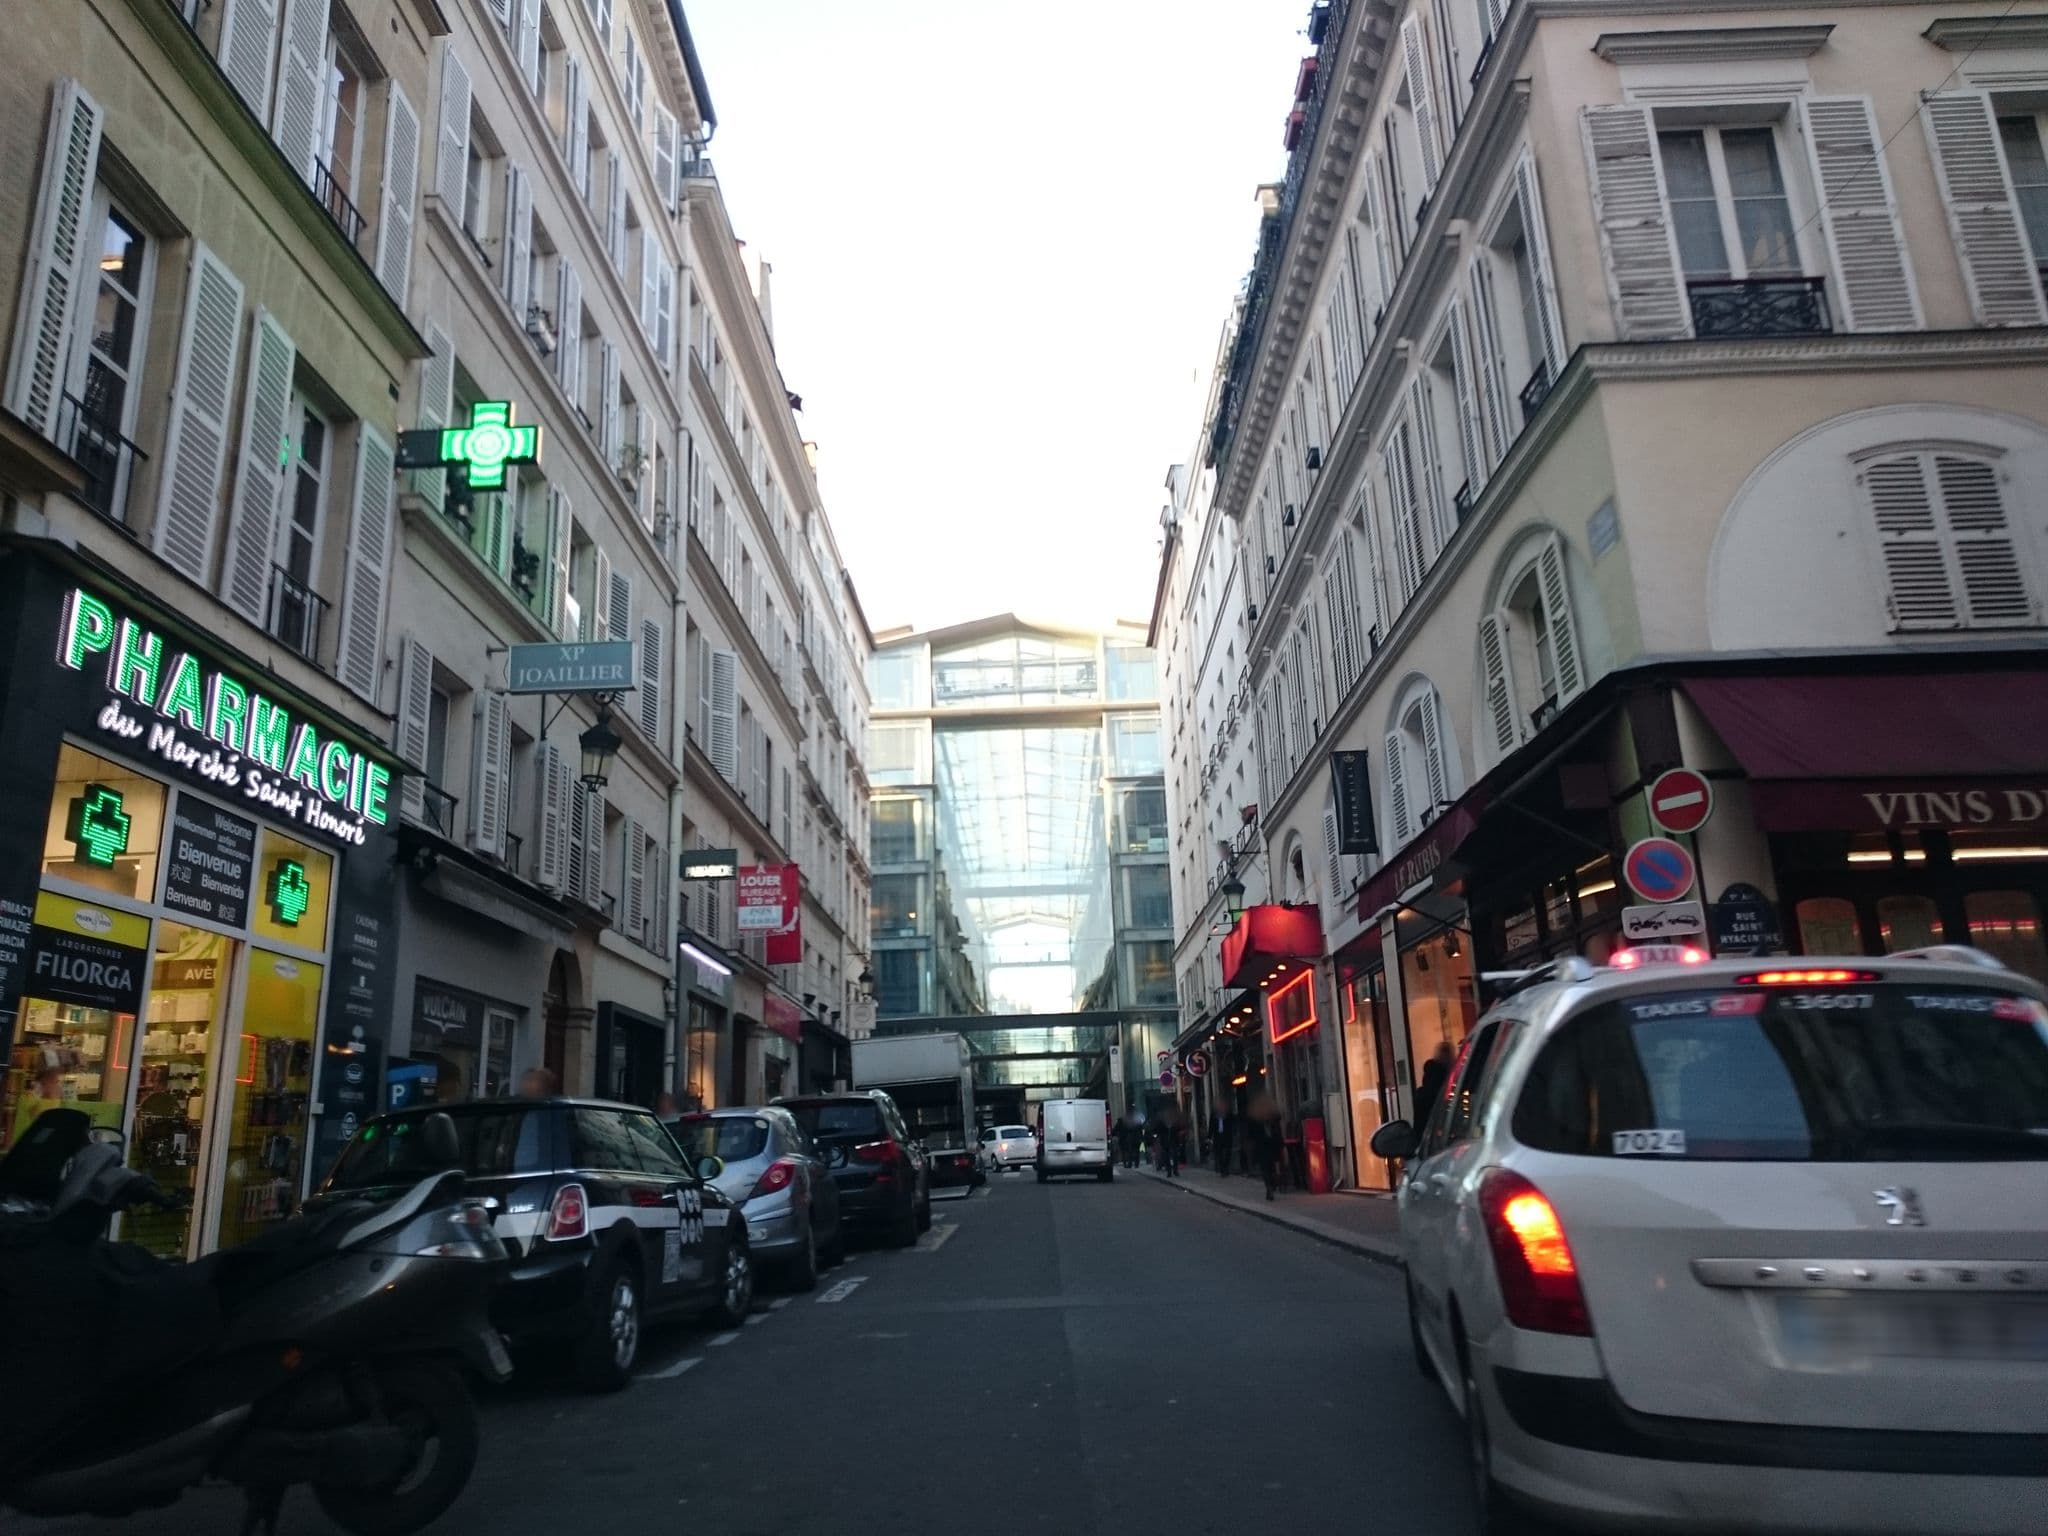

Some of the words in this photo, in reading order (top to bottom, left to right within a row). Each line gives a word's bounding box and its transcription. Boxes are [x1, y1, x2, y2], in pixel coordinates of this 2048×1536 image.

[560, 646, 585, 661] XP
[519, 664, 624, 686] JOAILLIER
[57, 588, 390, 826] PHARMACIE
[97, 700, 143, 738] du
[148, 723, 241, 786] Marché
[244, 770, 303, 814] Saint
[306, 797, 366, 845] Honoré
[1862, 790, 1994, 825] VINS
[215, 813, 253, 840] Welcome
[178, 840, 242, 879] Bienvenue
[1407, 839, 1442, 885] RUBIS
[201, 873, 245, 900] Bienvenida
[740, 875, 781, 887] LOUER
[166, 886, 212, 912] Benvenuto
[1735, 912, 1758, 921] RUE
[35, 950, 133, 991] FILORGA
[1630, 1000, 1708, 1019] TAXIS
[391, 1083, 405, 1105] P
[1615, 1131, 1684, 1151] 7024
